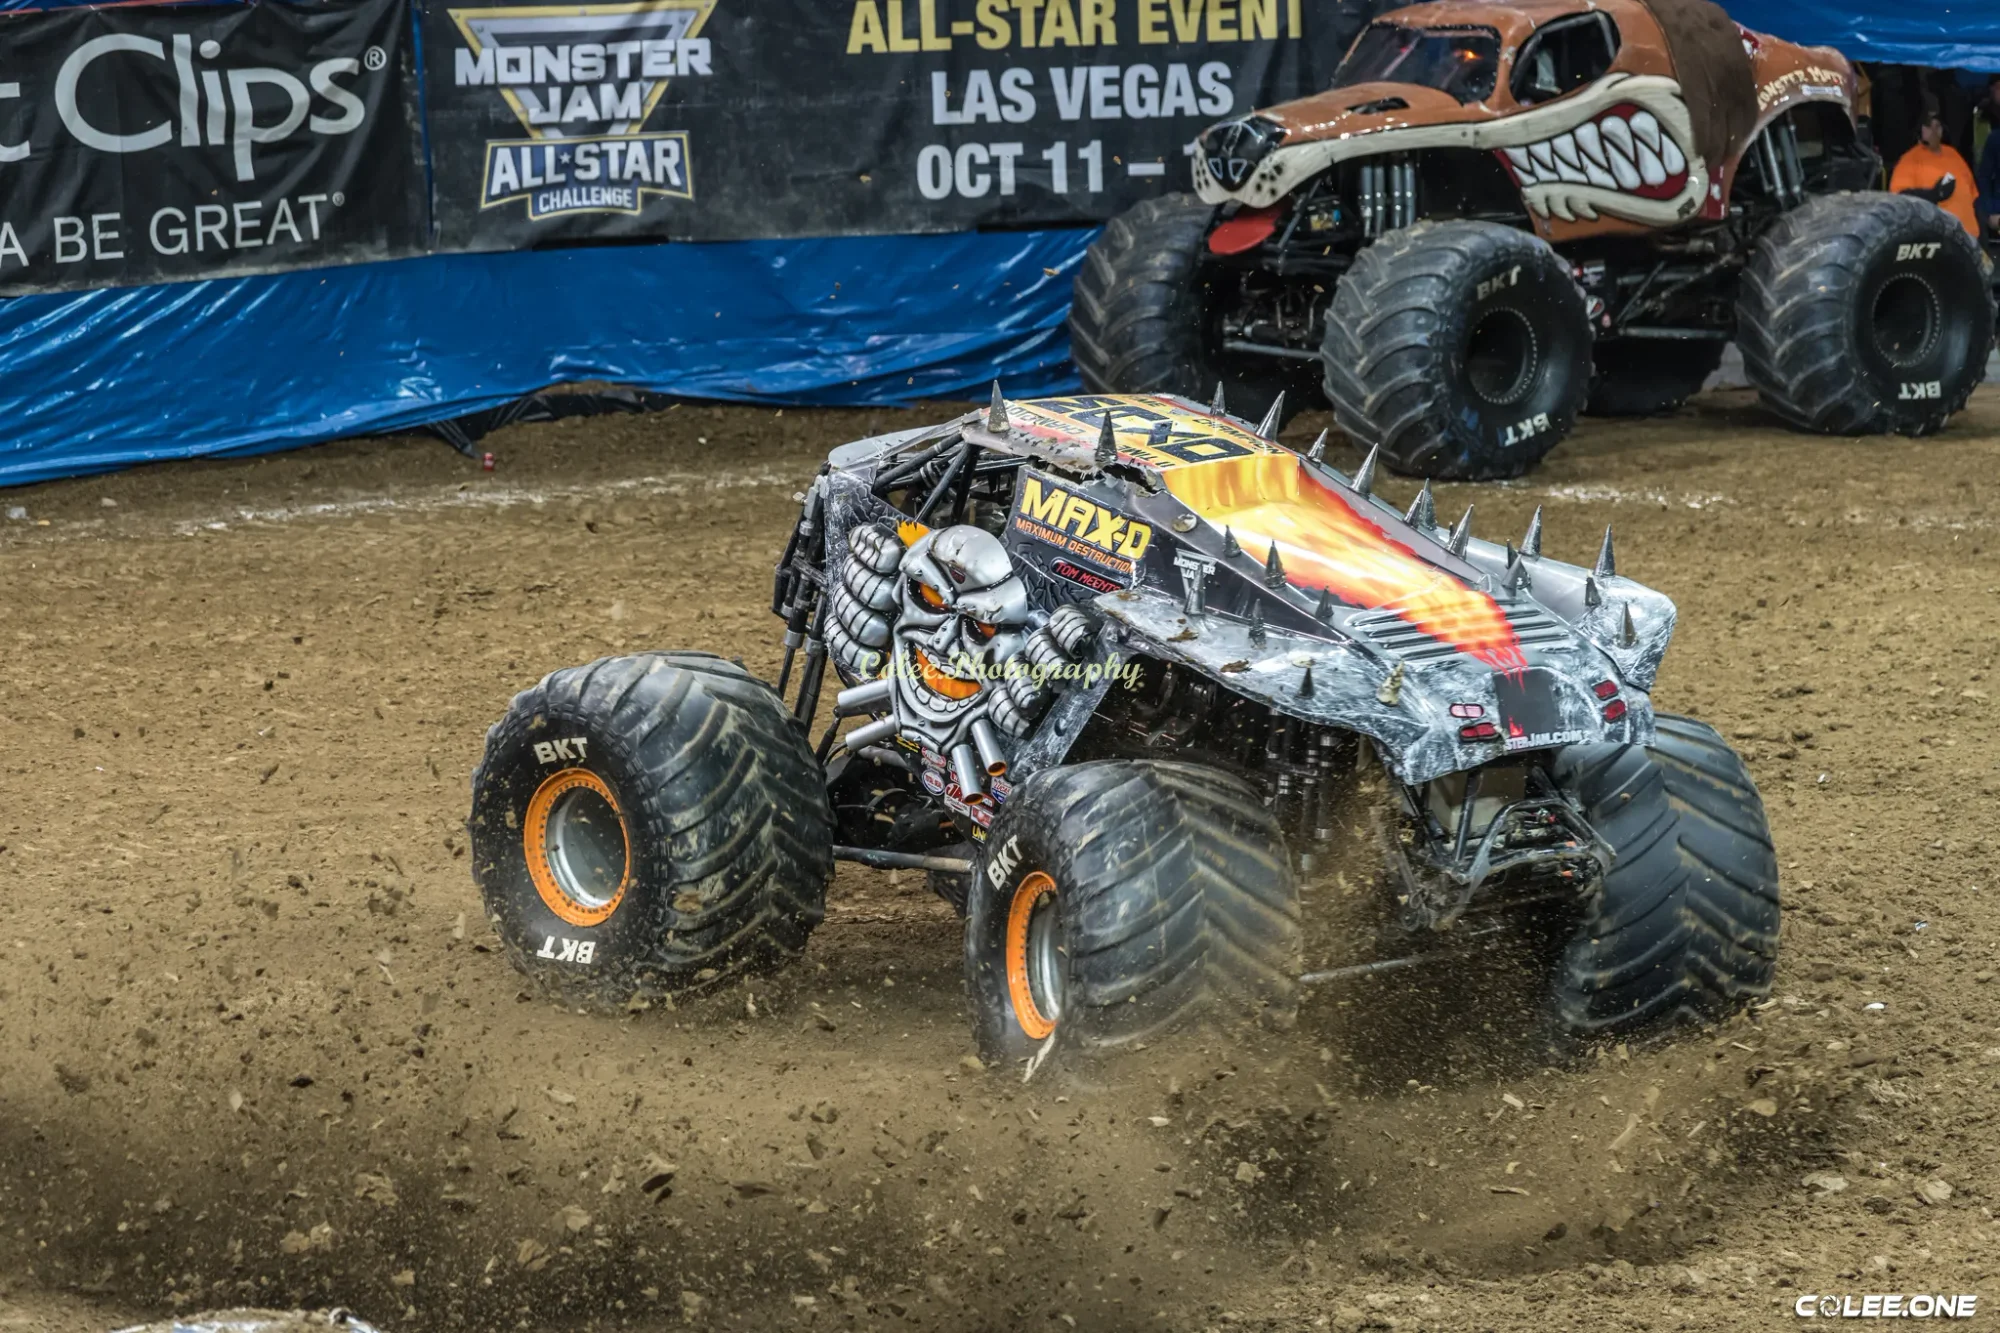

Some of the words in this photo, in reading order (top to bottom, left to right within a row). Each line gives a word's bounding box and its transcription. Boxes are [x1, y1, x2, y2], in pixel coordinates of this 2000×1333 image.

[845, 0, 1118, 54] ALL-STAR
[455, 37, 713, 86] MONSTER
[527, 81, 643, 124] JAM
[931, 67, 1037, 126] LAS
[1048, 61, 1234, 121] VEGAS
[916, 141, 1024, 200] OCT
[1042, 140, 1104, 194] 11
[537, 186, 634, 213] CHALLENGE
[54, 211, 125, 264] BE
[1897, 241, 1942, 263] BKT
[1477, 264, 1521, 300] BKT
[1899, 380, 1942, 400] BKT
[1504, 411, 1552, 447] BKT
[1019, 477, 1153, 561] MAX-D
[1015, 516, 1068, 548] MAXIMUM
[1068, 539, 1136, 575] DESTRUCTION
[1054, 561, 1081, 581] TOM
[1173, 556, 1216, 576] MONSER
[532, 737, 589, 765] BKT
[987, 834, 1023, 892] BKT
[536, 934, 596, 965] BKT
